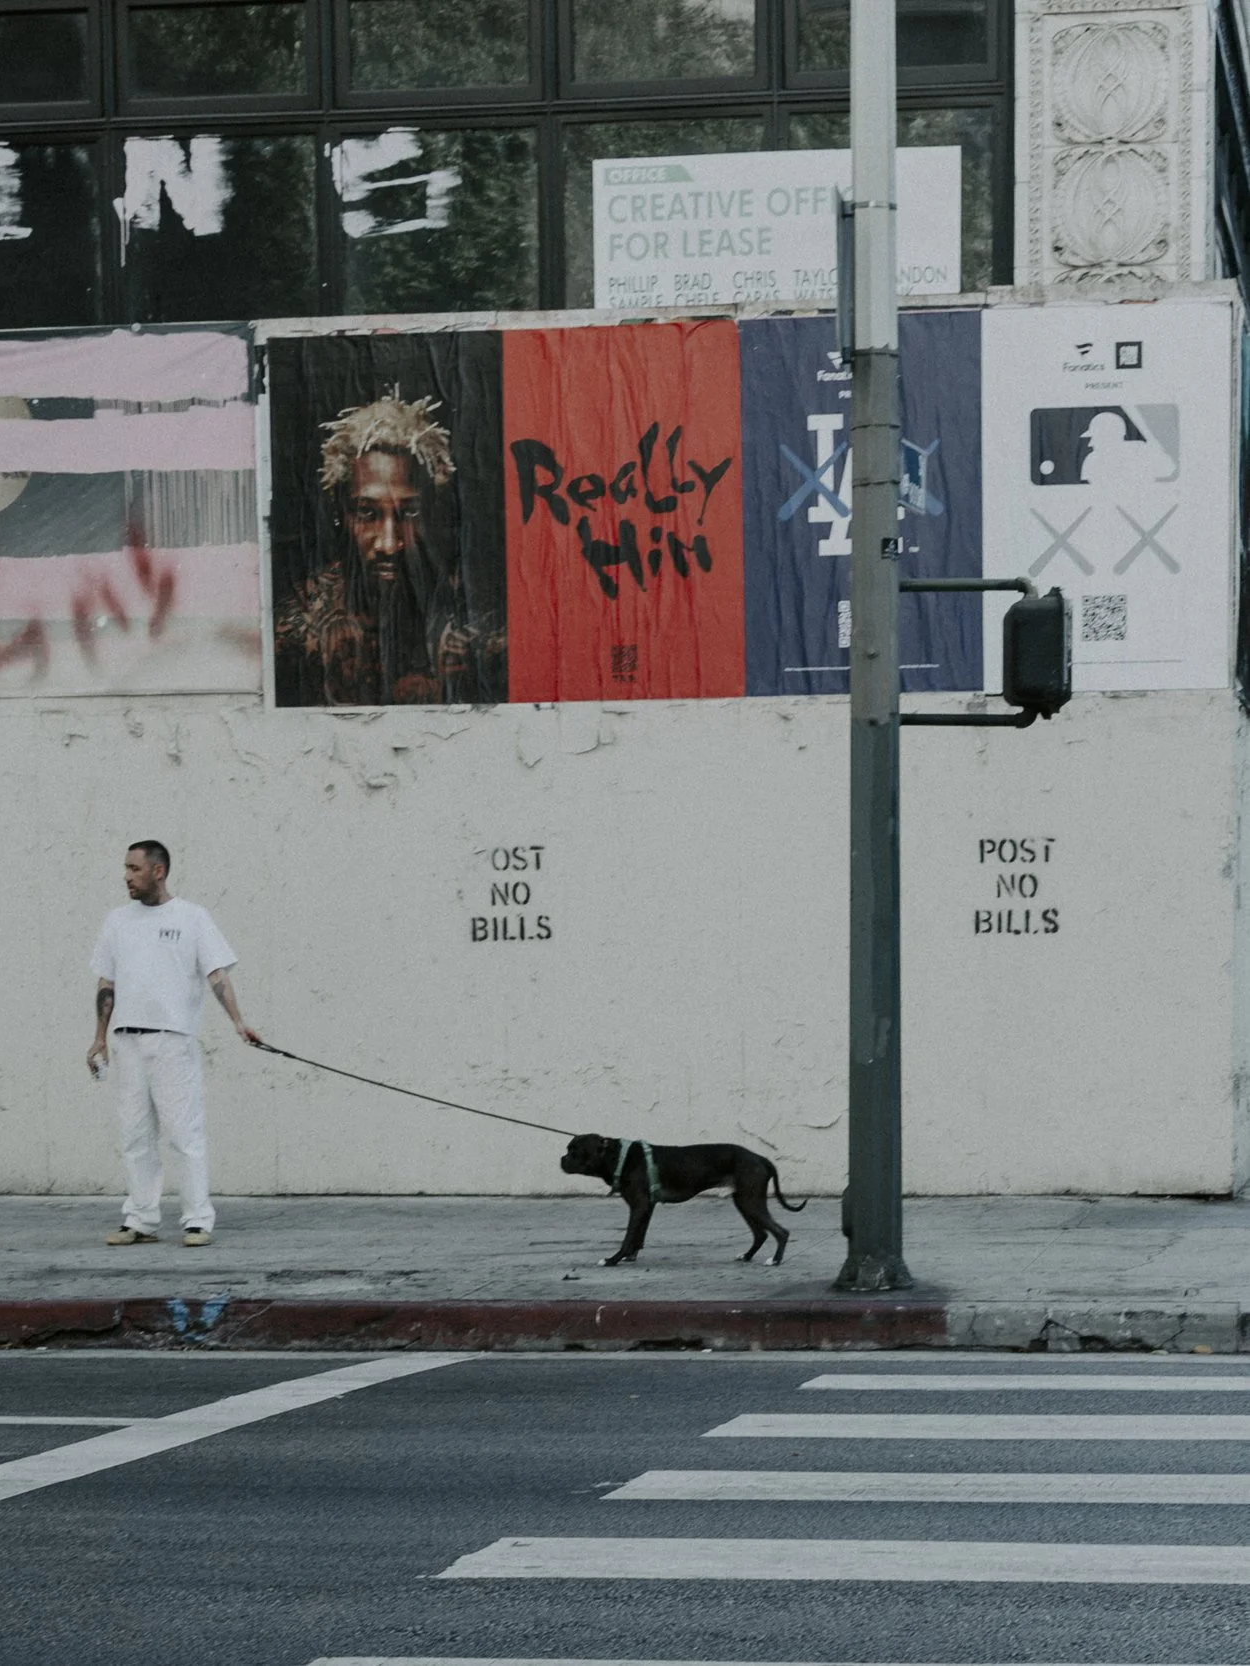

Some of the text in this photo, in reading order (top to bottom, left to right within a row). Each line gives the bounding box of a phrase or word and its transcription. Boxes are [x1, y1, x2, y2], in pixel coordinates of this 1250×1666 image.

[608, 169, 667, 183] OFFICE
[608, 186, 853, 223] CREATIVE OFFI
[609, 226, 772, 262] FOR LEASE
[609, 274, 659, 294] PHILLIP
[673, 272, 712, 291] BRAD
[733, 270, 777, 289] CHRIS
[896, 265, 948, 285] NDON
[474, 845, 545, 872] OST
[979, 838, 1056, 864] POST
[491, 881, 531, 906] NO
[996, 873, 1038, 899] NO
[471, 915, 552, 942] BILLS
[974, 907, 1059, 936] BILLS
